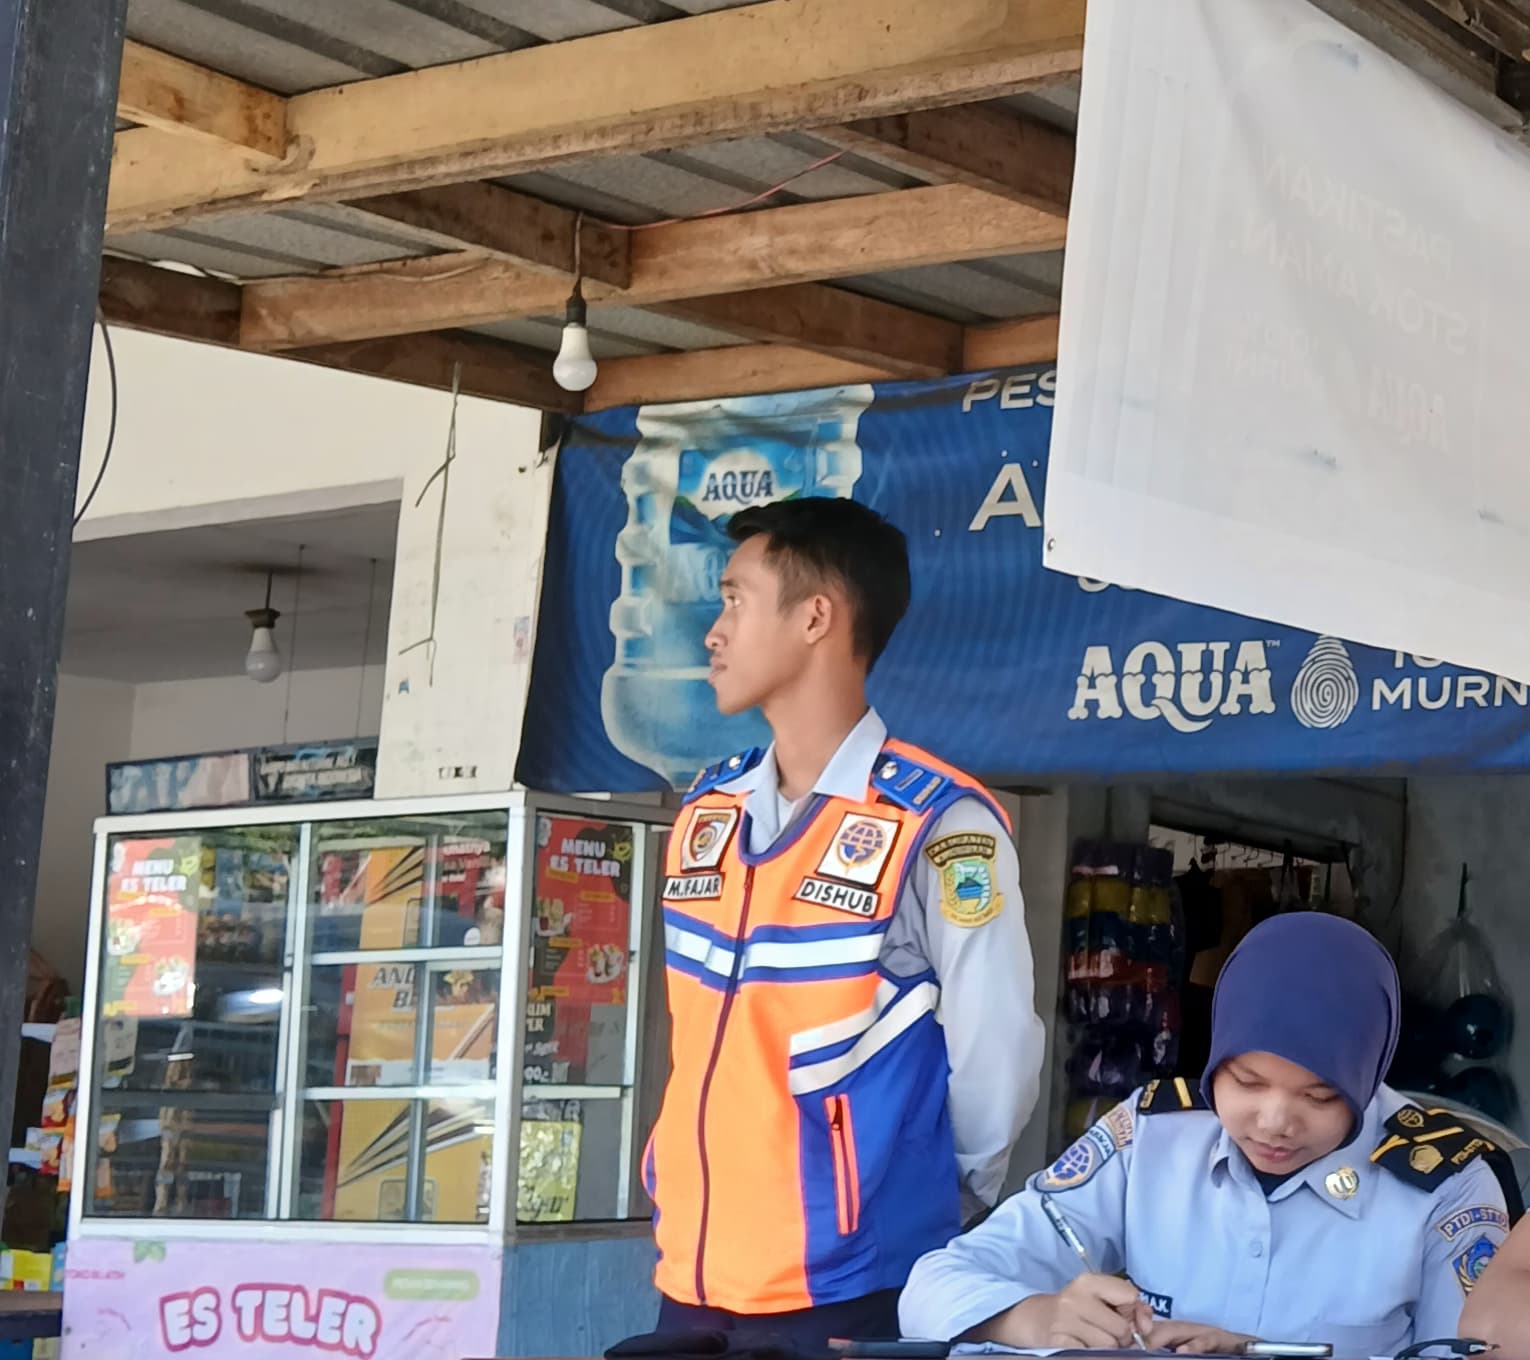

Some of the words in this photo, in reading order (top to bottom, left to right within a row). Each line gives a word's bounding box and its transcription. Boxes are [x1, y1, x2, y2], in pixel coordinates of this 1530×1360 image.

[702, 470, 773, 505] AQUA
[1067, 640, 1276, 733] AQUA
[561, 838, 606, 858] MENU
[549, 855, 569, 872] ES
[574, 858, 621, 878] TELER
[800, 881, 873, 913] DISHUB
[159, 1285, 223, 1353] ES
[231, 1282, 383, 1360] TELER
